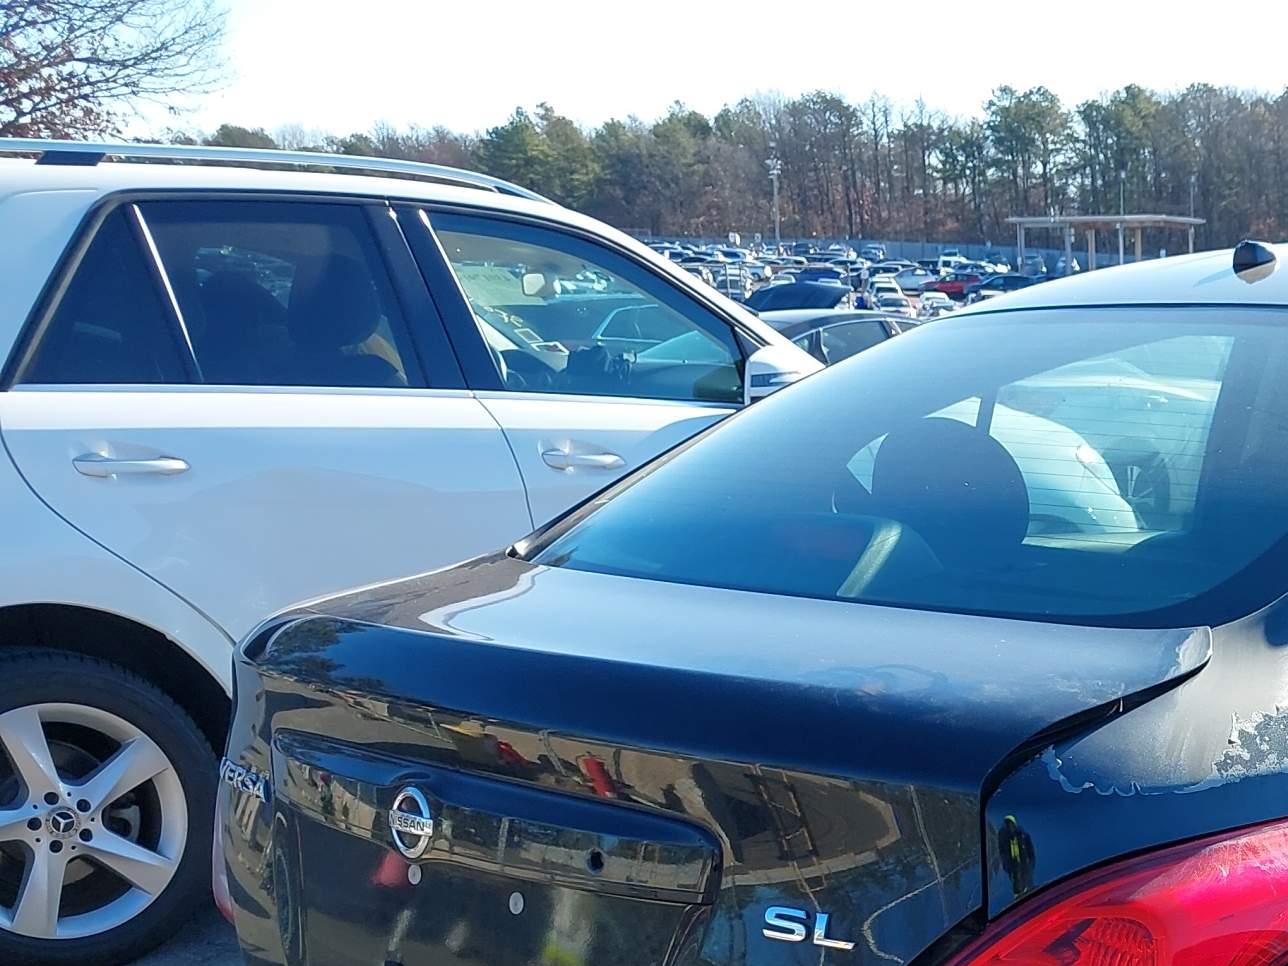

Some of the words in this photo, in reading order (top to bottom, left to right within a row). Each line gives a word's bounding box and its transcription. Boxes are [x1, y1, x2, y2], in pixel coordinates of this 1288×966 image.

[219, 757, 268, 802] VERSA
[390, 810, 426, 832] NISSAN
[761, 906, 857, 950] SL
